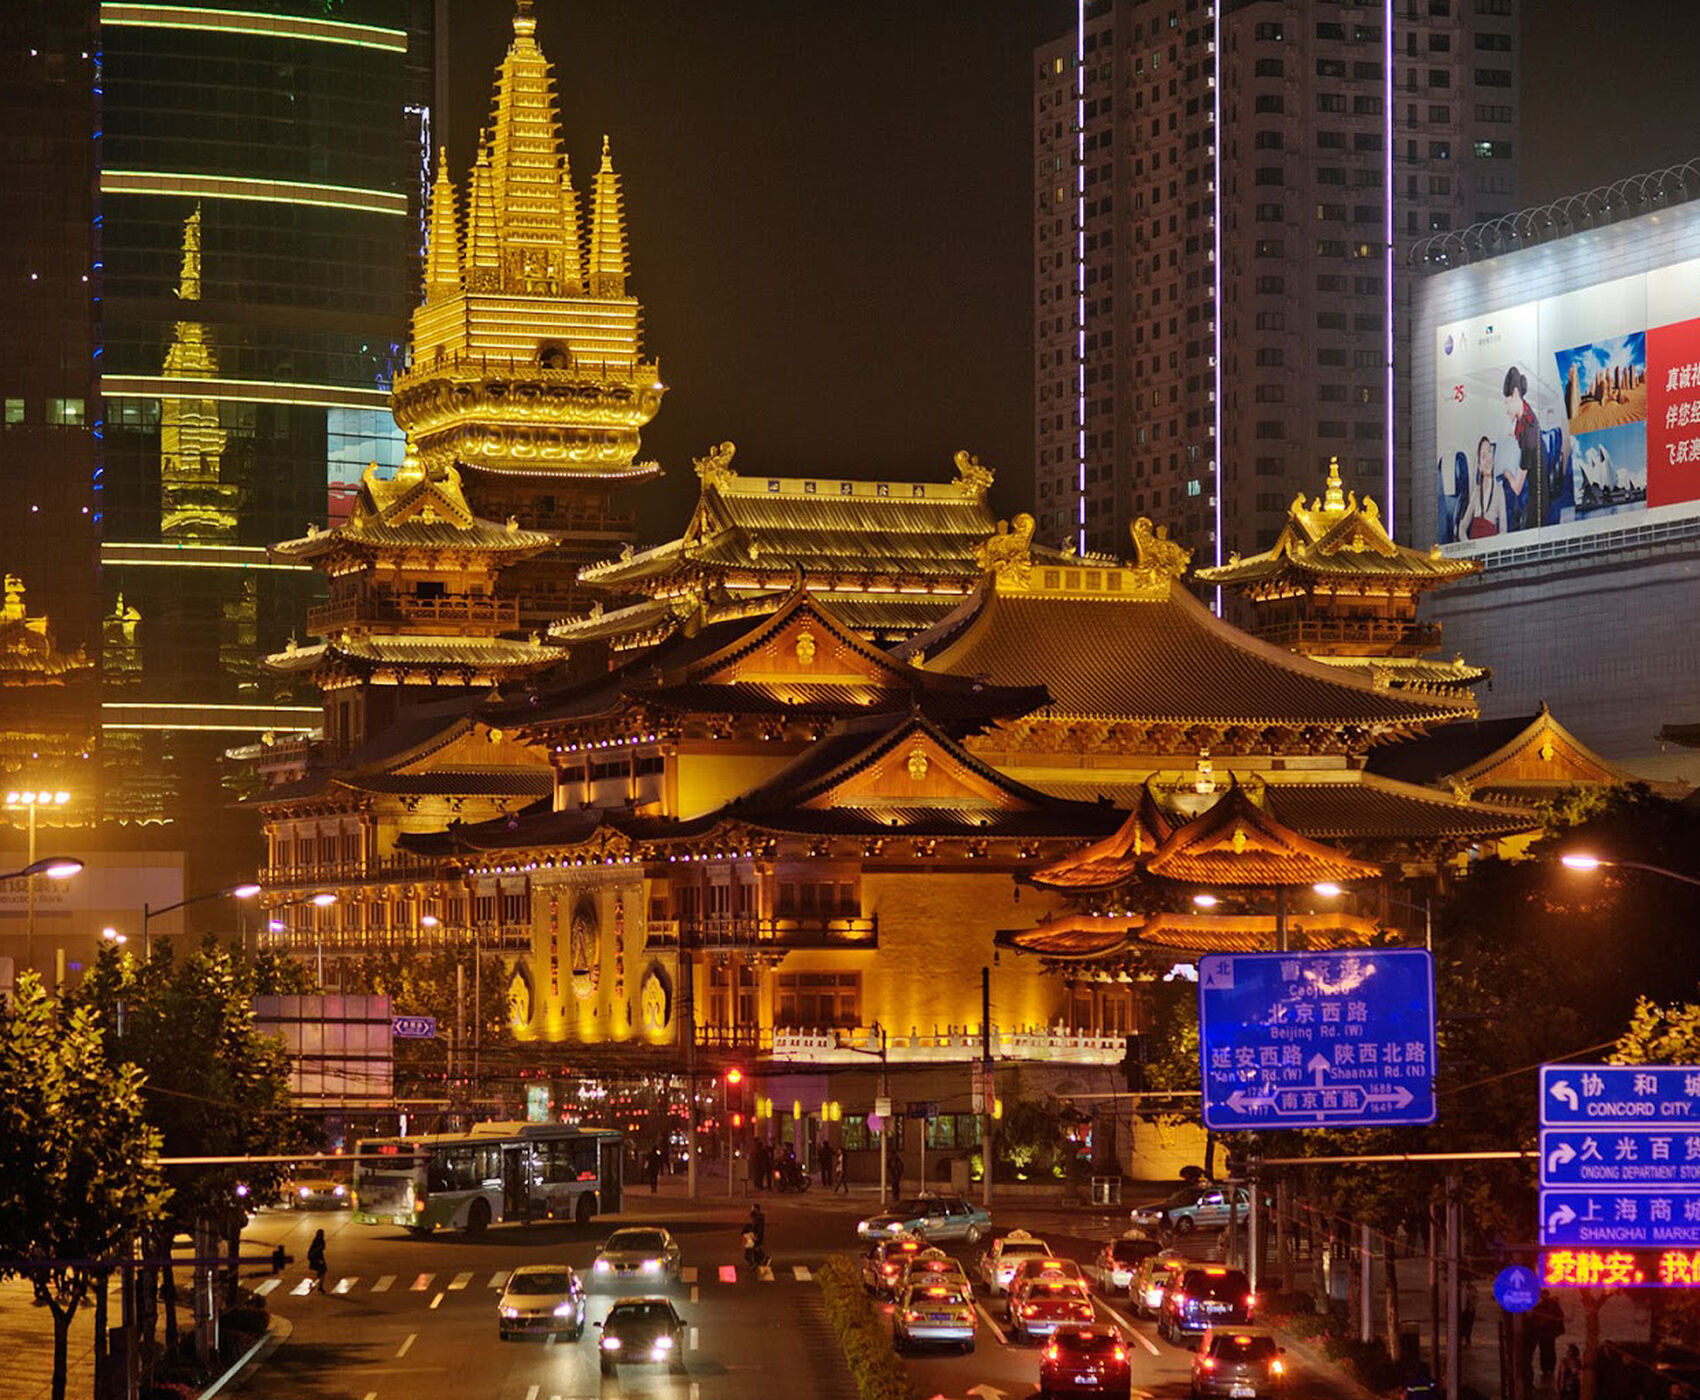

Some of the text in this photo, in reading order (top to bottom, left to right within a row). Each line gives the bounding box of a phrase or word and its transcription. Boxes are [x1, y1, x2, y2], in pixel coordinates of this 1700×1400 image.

[1217, 960, 1231, 975] 北
[1268, 1001, 1368, 1024] 北京西路
[1271, 1026, 1312, 1041] Beijing
[1211, 1045, 1303, 1068] 延安西路
[1334, 1041, 1427, 1065] 陕西北路
[1330, 1067, 1378, 1080] Shaanxi
[1282, 1090, 1359, 1110] 南京西路
[1587, 1102, 1692, 1116] CONCORD CITY
[1622, 1166, 1676, 1179] DEPARTMENT
[1580, 1227, 1646, 1241] SHANGHAI
